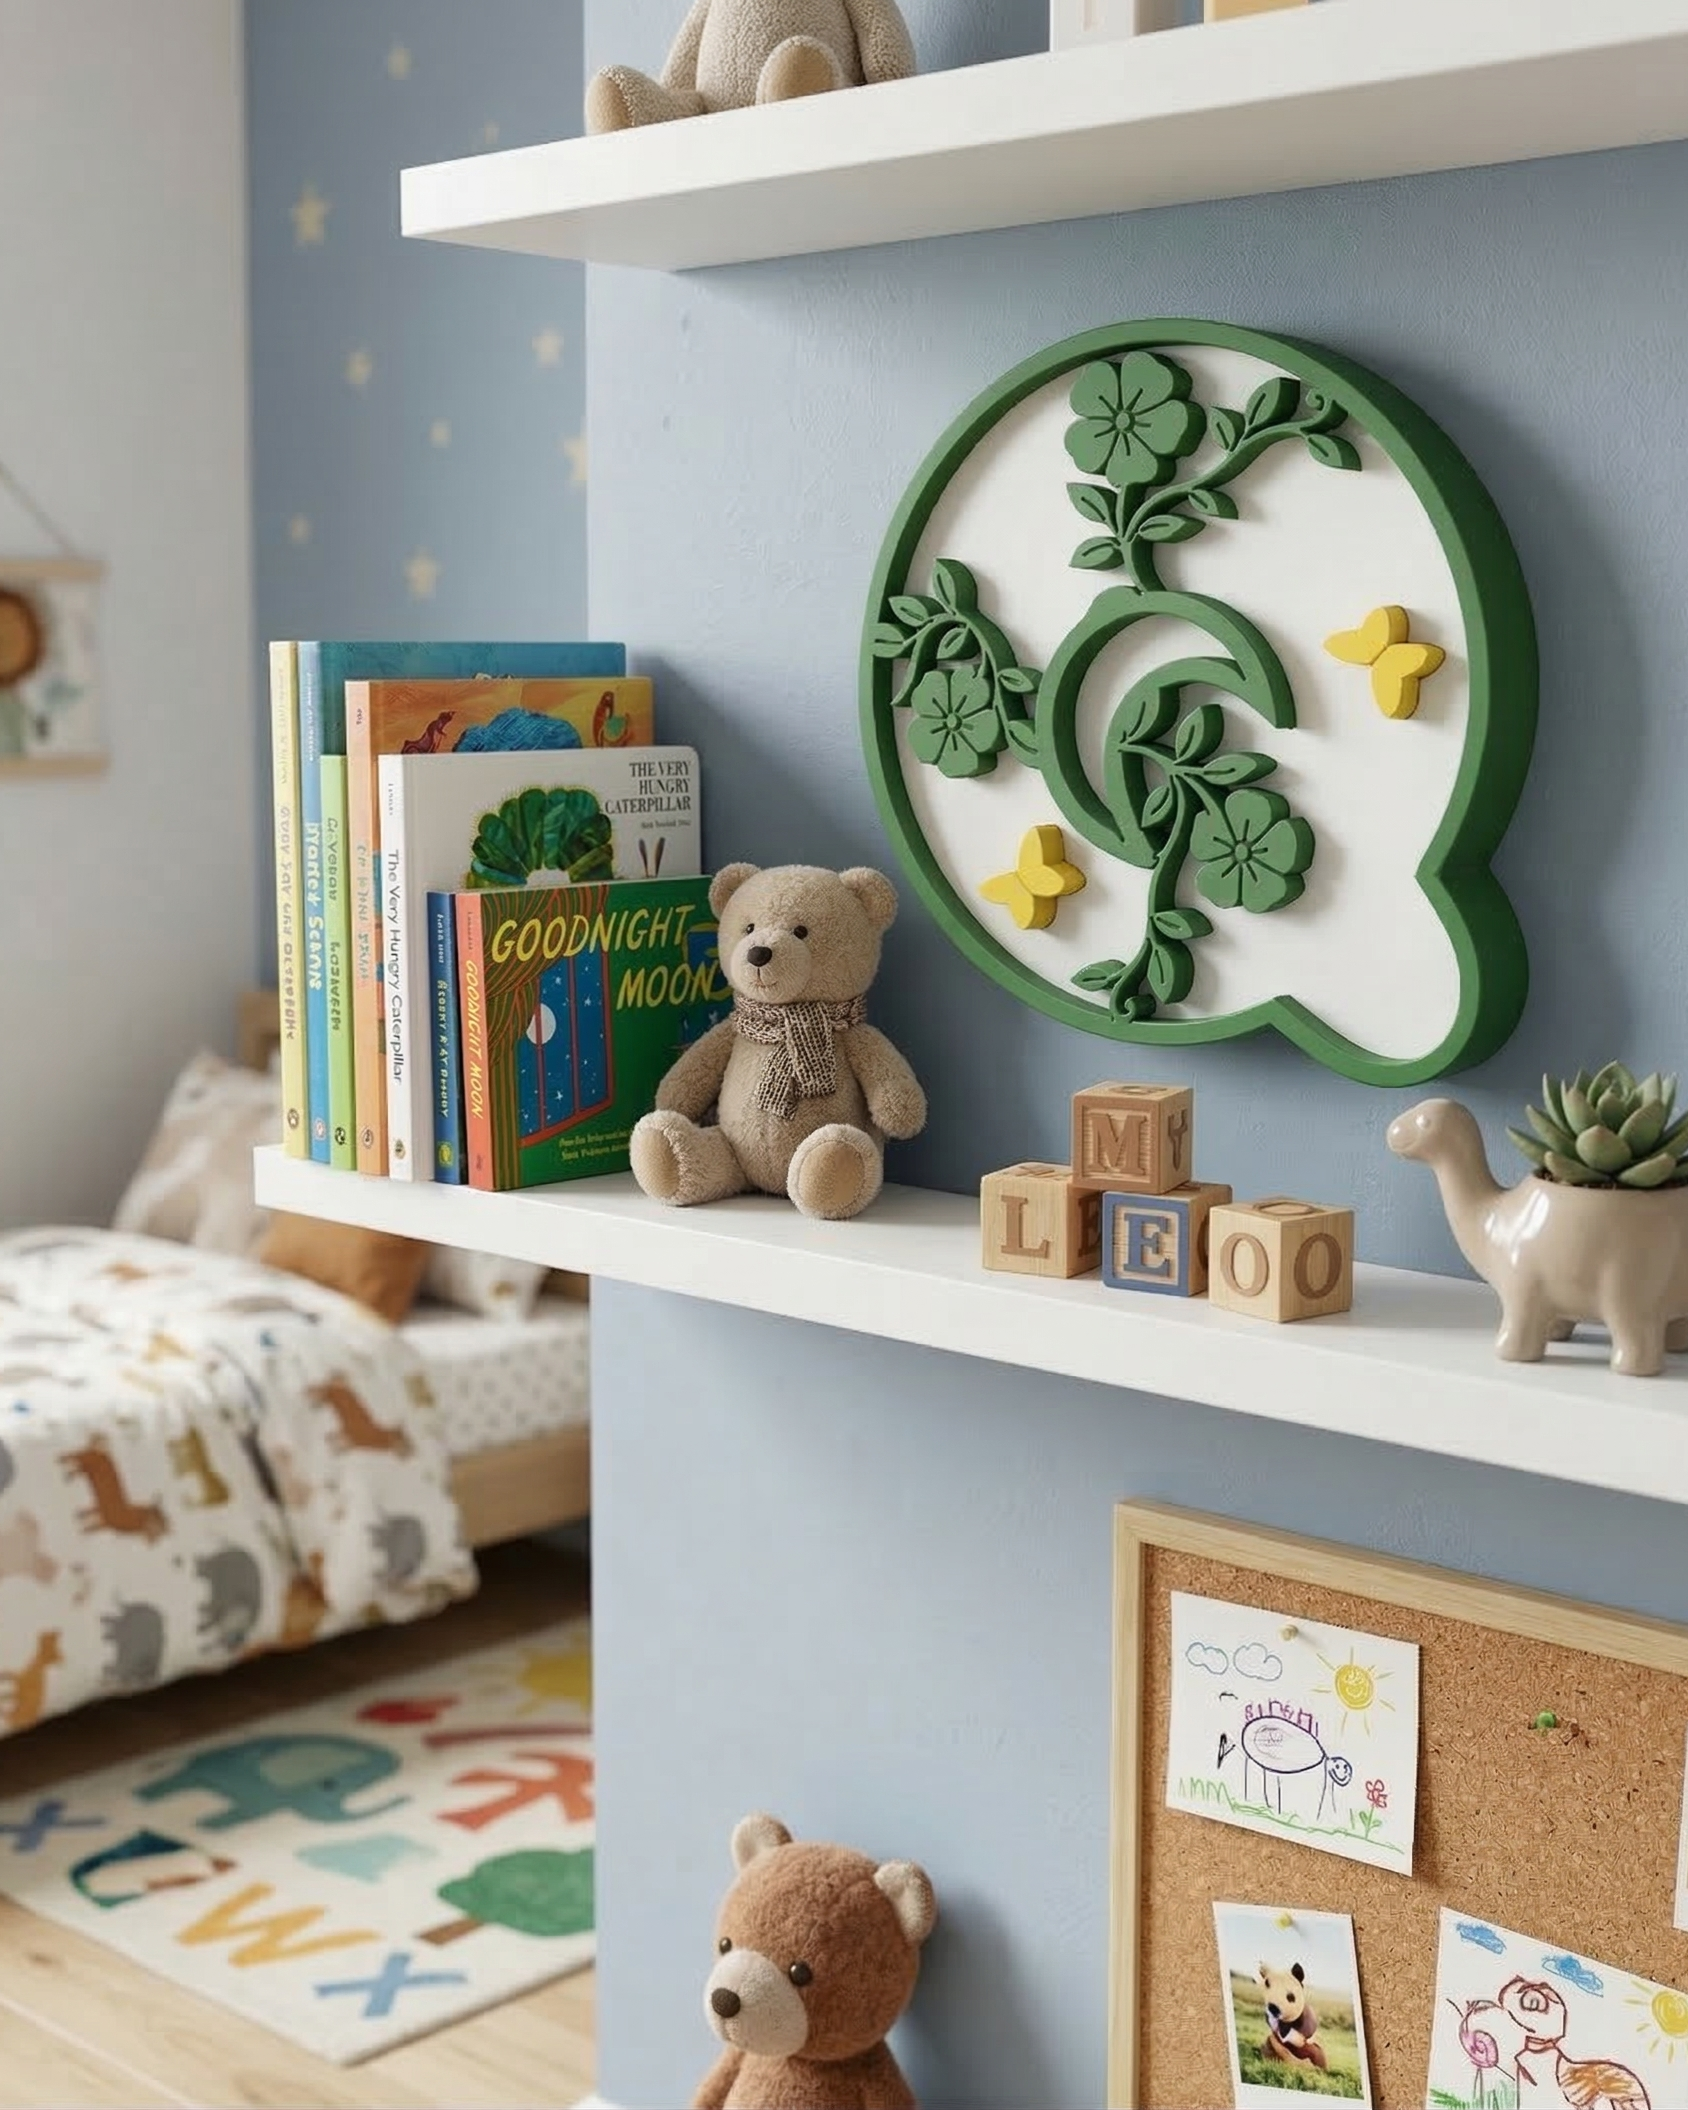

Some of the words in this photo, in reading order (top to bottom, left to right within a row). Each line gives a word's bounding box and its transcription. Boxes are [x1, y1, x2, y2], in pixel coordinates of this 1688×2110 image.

[629, 761, 656, 777] THE
[658, 760, 692, 776] VERY
[639, 778, 691, 795] HUNGRY
[605, 795, 692, 814] CATERPILLAR
[388, 850, 400, 881] The
[387, 886, 401, 924] Very
[491, 904, 696, 964] GOODNIGHT
[388, 930, 402, 990] Hungry
[616, 959, 719, 1011] MOON
